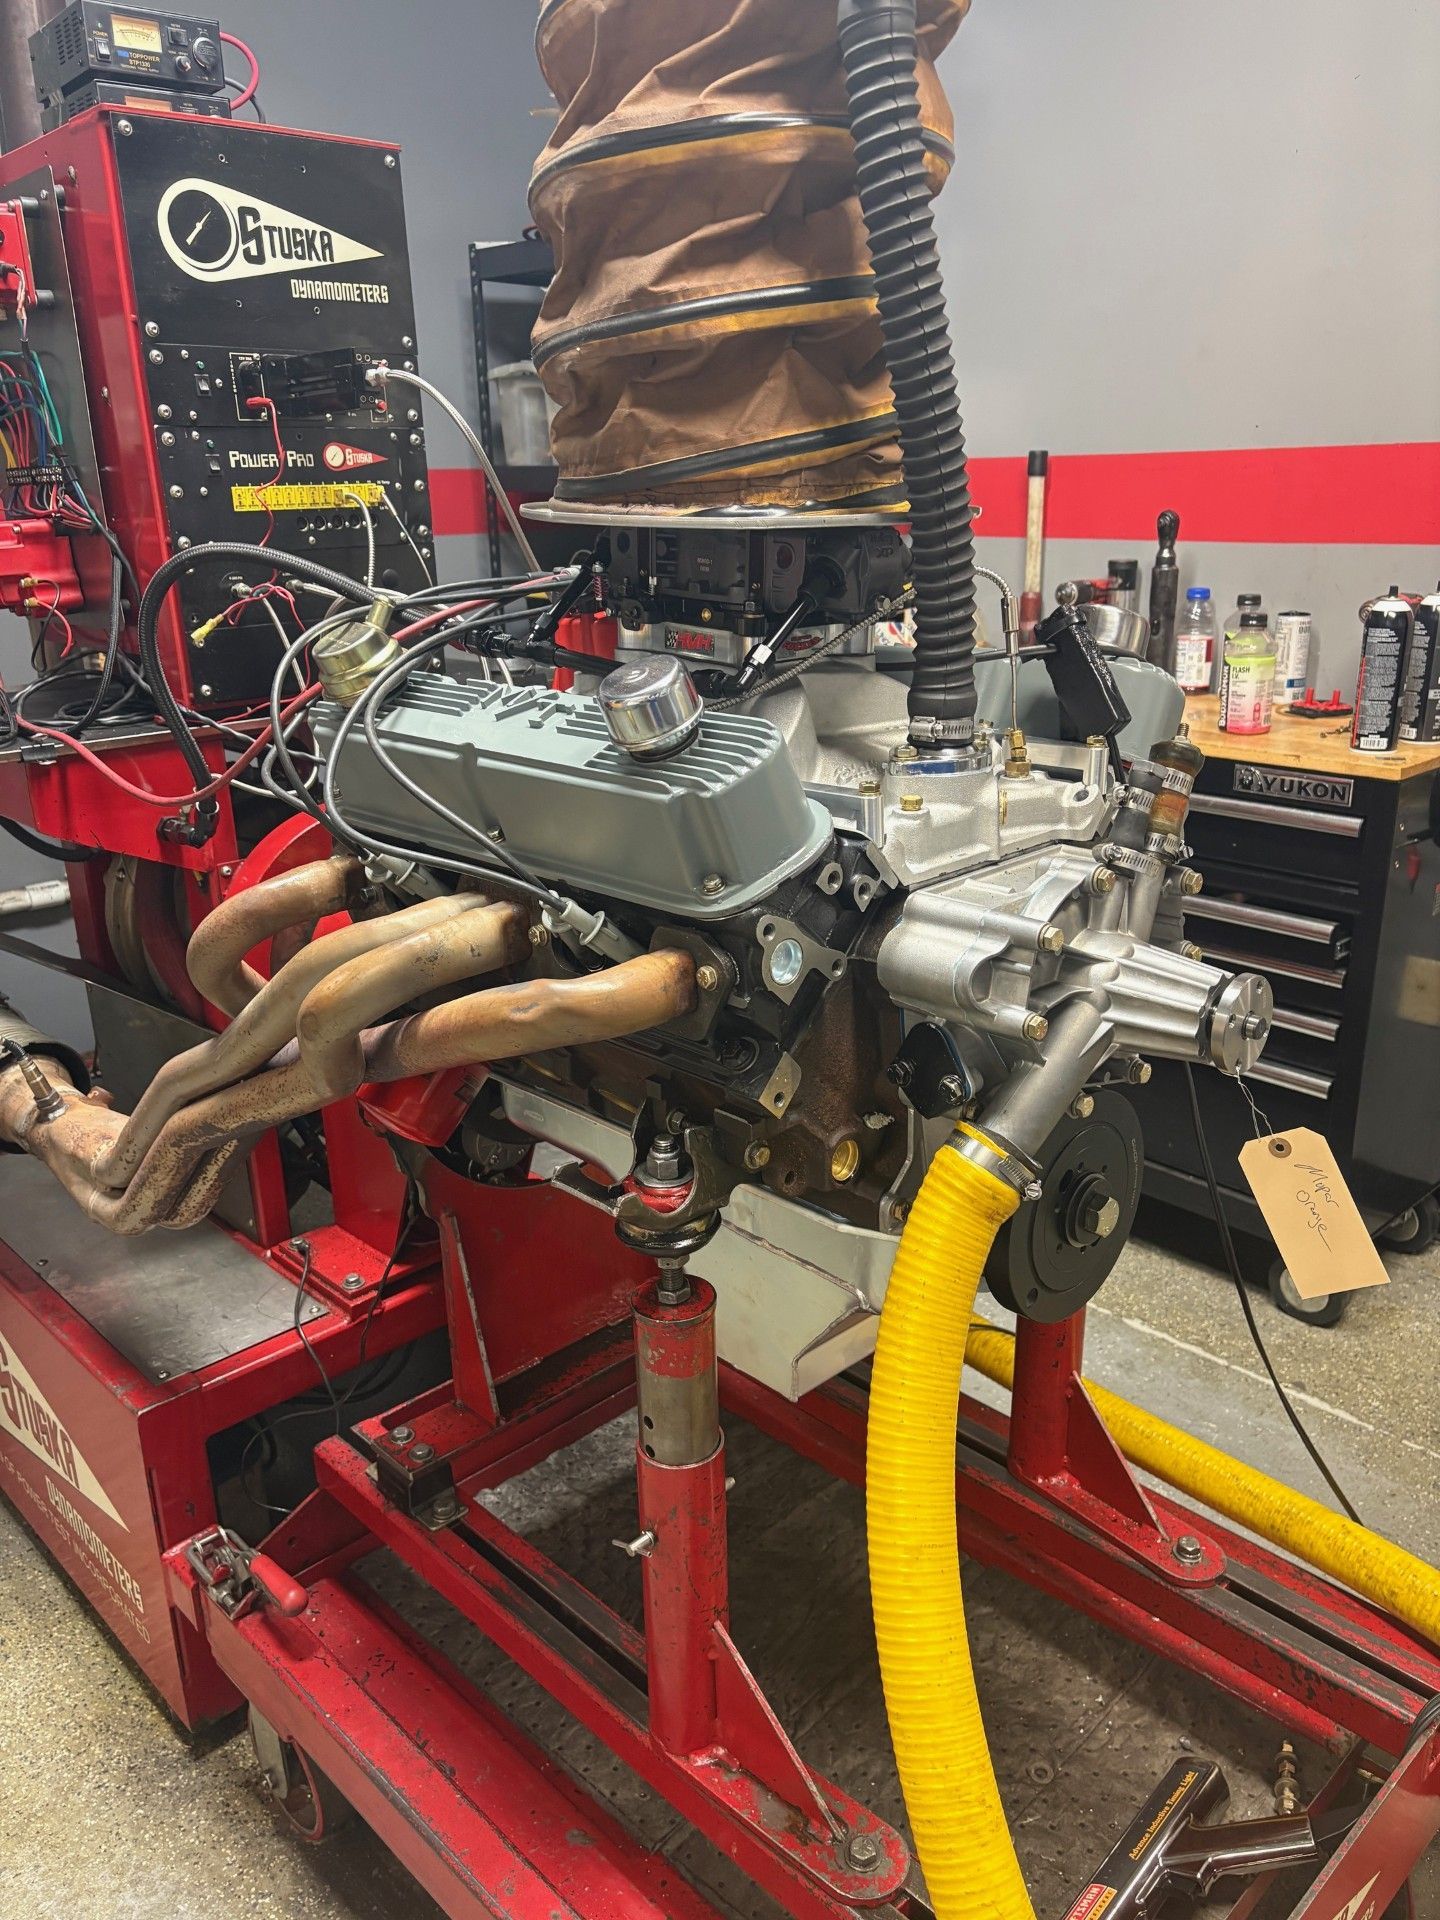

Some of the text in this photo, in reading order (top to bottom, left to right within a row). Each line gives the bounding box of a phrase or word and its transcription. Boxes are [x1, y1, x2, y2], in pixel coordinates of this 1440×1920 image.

[238, 206, 334, 266] STUSKA
[290, 278, 389, 304] DYNAMOMETERS
[229, 450, 315, 468] POWER PRO
[345, 448, 373, 466] STUSKA
[1218, 664, 1230, 727] BODYARMOR
[1262, 775, 1347, 801] YUKON
[44, 1474, 145, 1614] DYNAMOMETERS
[1128, 1771, 1195, 1860] Advance Inductive Timing Light
